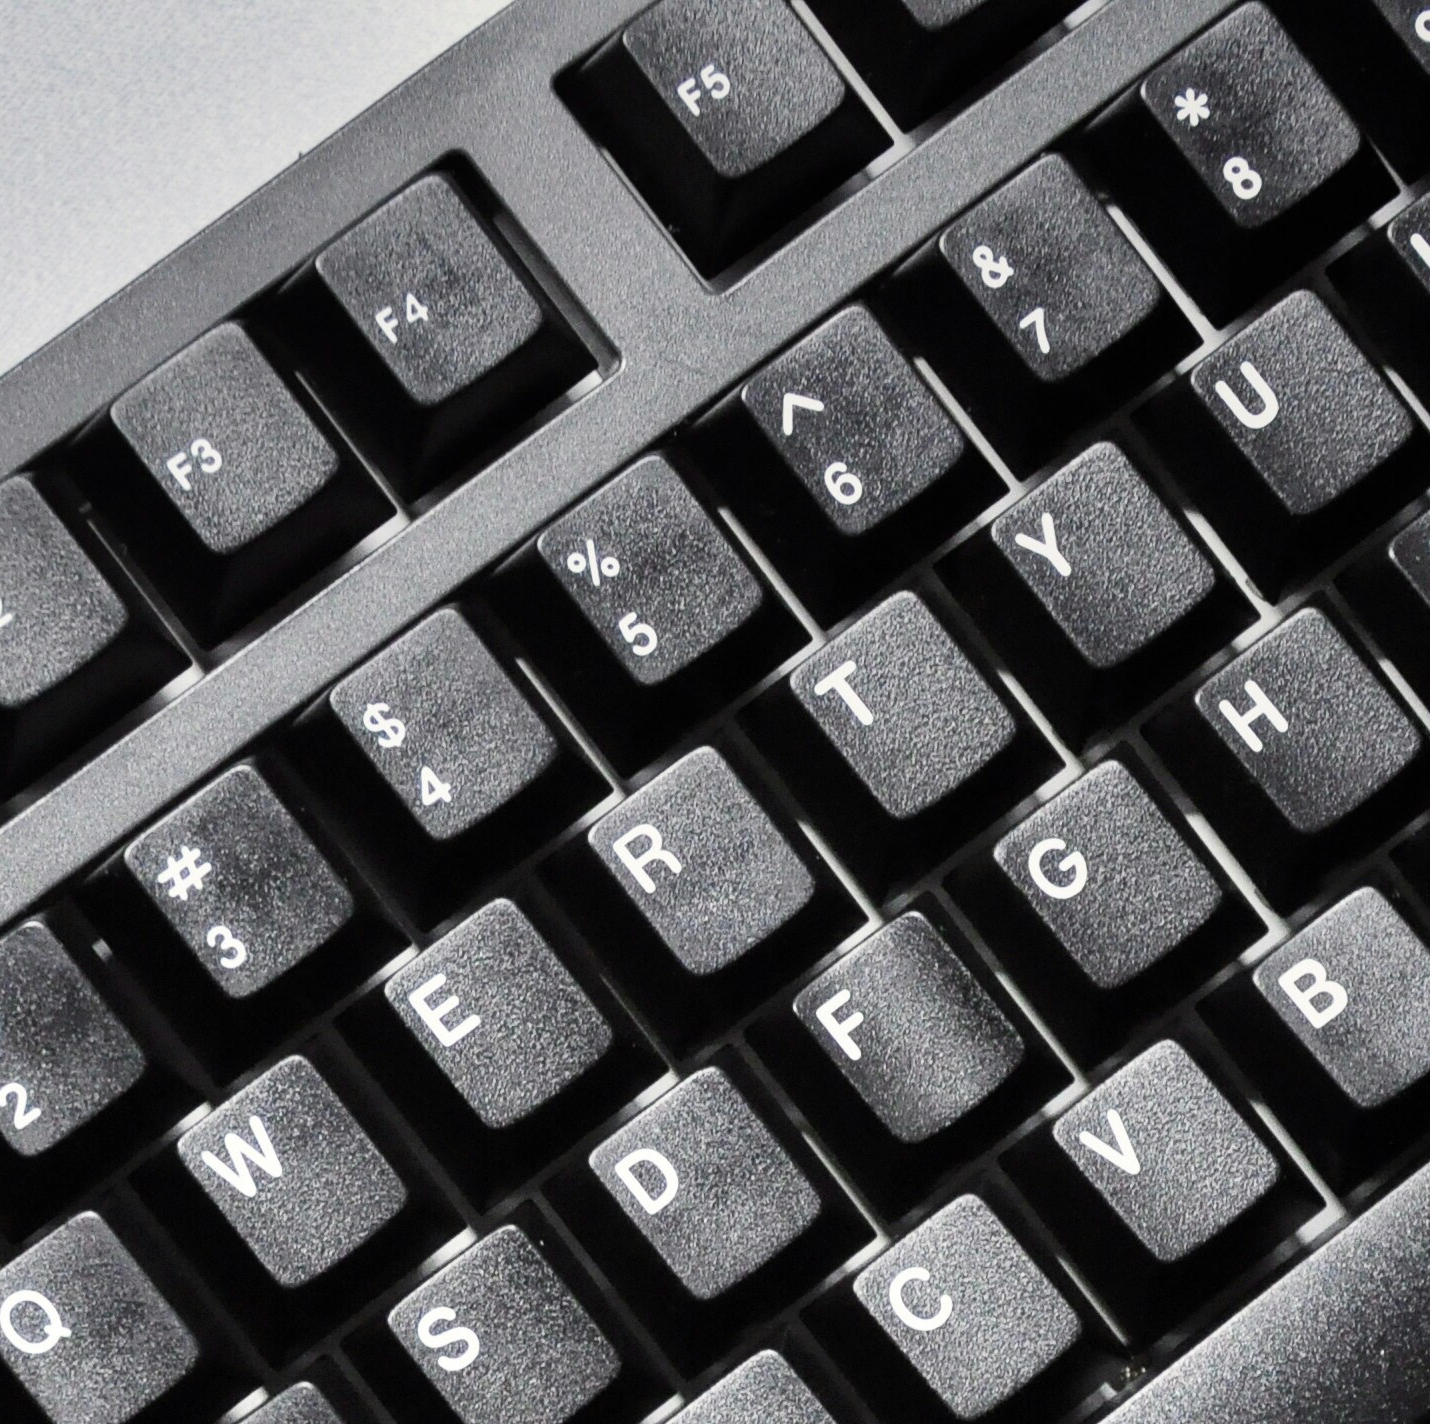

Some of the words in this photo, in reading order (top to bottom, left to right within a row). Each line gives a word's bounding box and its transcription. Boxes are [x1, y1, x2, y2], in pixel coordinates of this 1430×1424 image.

[677, 63, 731, 117] F5
[1222, 156, 1263, 200] 8
[971, 244, 1015, 289] &
[374, 292, 429, 344] F4
[1019, 307, 1051, 354] 7
[782, 392, 825, 436] ^
[1214, 360, 1280, 430] U
[165, 437, 223, 491] F3
[823, 461, 864, 506] 6
[566, 538, 621, 587] %
[1014, 511, 1073, 578] Y
[617, 611, 659, 657] 5
[813, 659, 875, 727] T
[1218, 678, 1290, 753] H
[361, 701, 408, 749] $
[419, 765, 453, 807] 4
[156, 844, 213, 902] #
[611, 821, 684, 895] R
[1027, 836, 1089, 900] G
[205, 923, 248, 970] 3
[407, 971, 484, 1049] E
[1277, 956, 1349, 1030] B
[815, 987, 865, 1062] F
[200, 1114, 286, 1201] W
[1077, 1106, 1143, 1178] V
[612, 1146, 681, 1216] D
[887, 1265, 956, 1334] C
[416, 1304, 481, 1373] S
